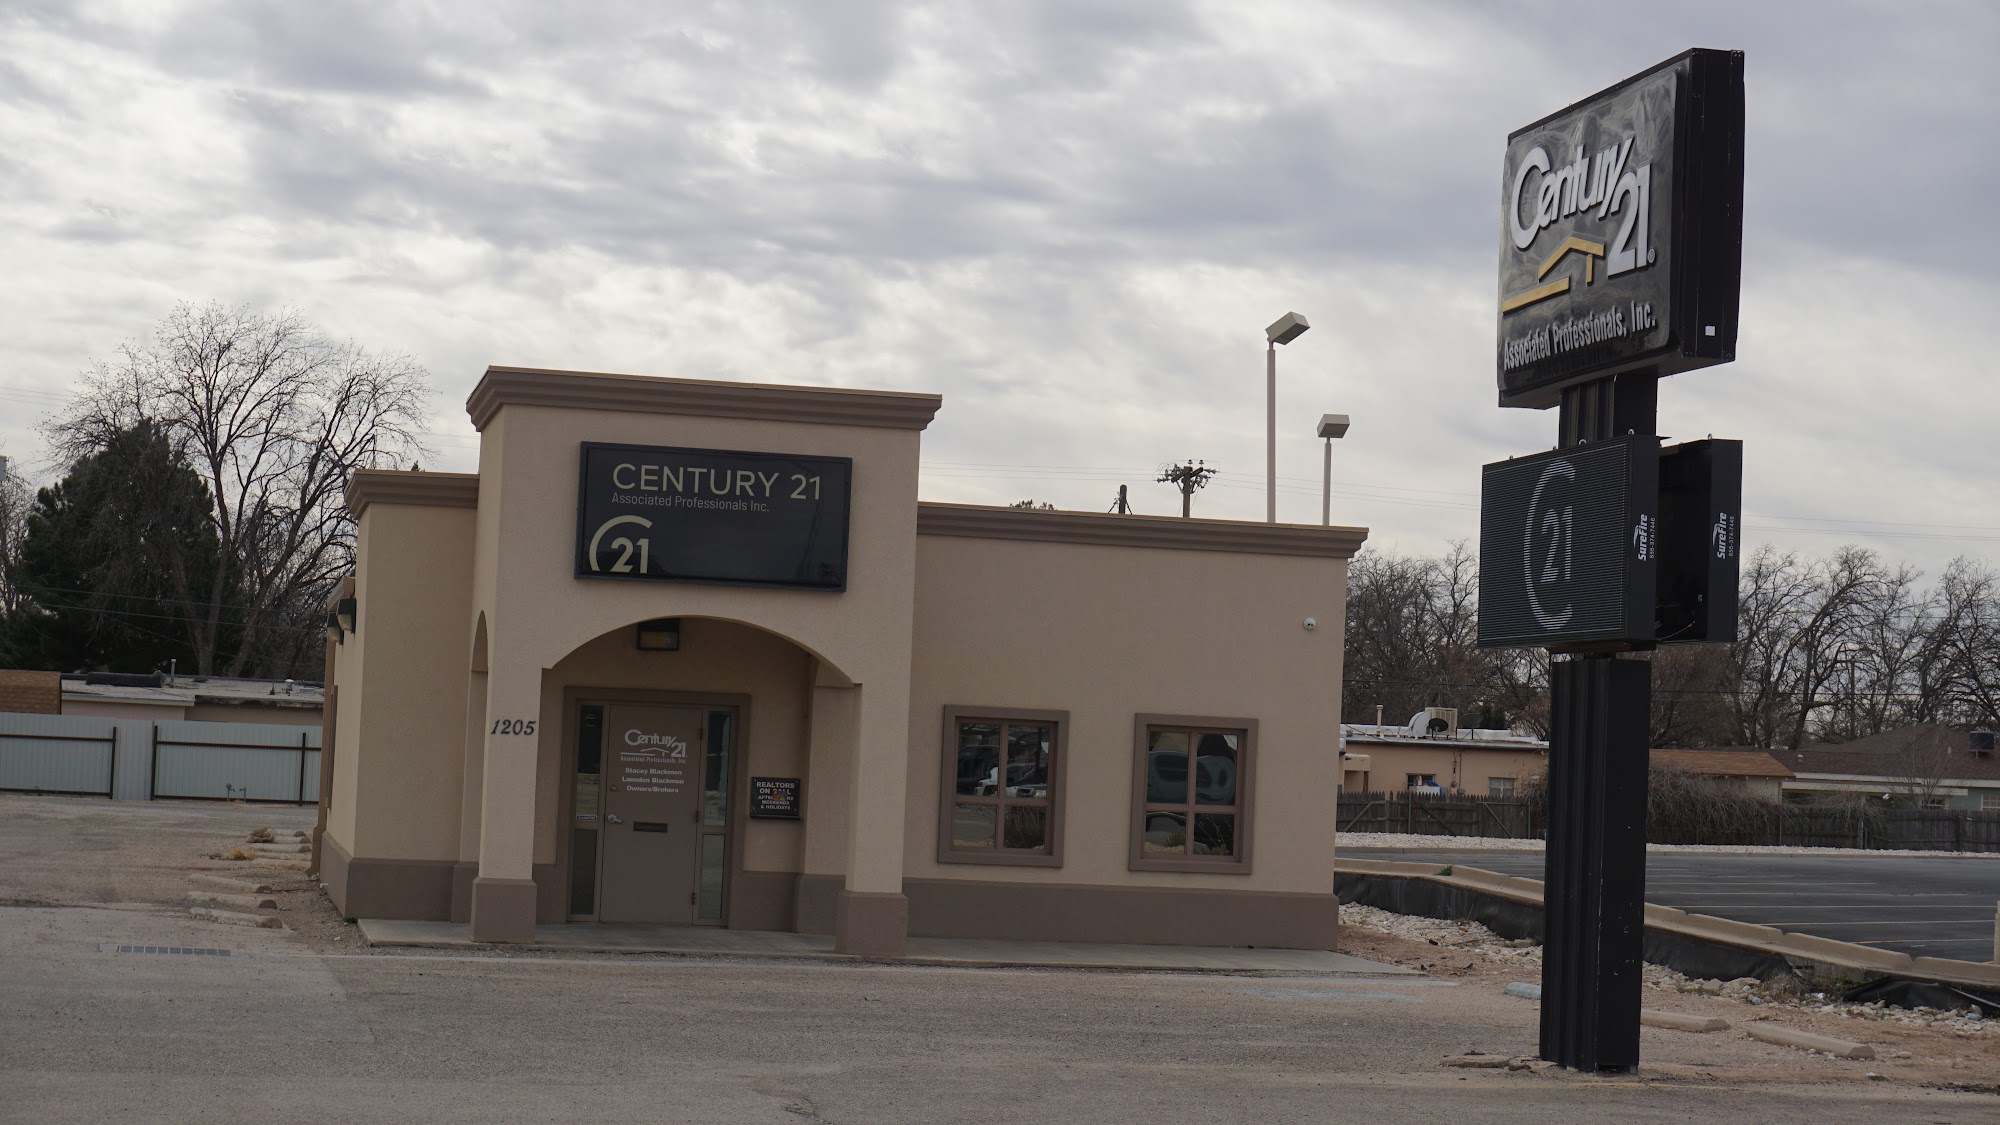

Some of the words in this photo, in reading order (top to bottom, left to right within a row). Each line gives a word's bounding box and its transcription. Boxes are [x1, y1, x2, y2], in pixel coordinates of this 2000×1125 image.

[1509, 137, 1634, 250] Century
[1503, 325, 1551, 370] Associated
[1552, 306, 1627, 354] Professionals,
[1630, 299, 1656, 332] Inc.
[612, 463, 780, 498] CENTURY
[789, 474, 821, 500] 21
[611, 491, 673, 507] Associated
[674, 496, 748, 512] Professionals
[750, 499, 770, 512] Inc.
[1540, 505, 1573, 582] 21
[1638, 513, 1648, 561] SureFire
[1716, 512, 1727, 559] SureFire
[610, 536, 650, 574] 21
[490, 719, 537, 736] 1205
[624, 729, 677, 748] Century
[671, 741, 687, 758] 21
[625, 767, 649, 775] Stacey
[756, 781, 795, 789] REALTORS
